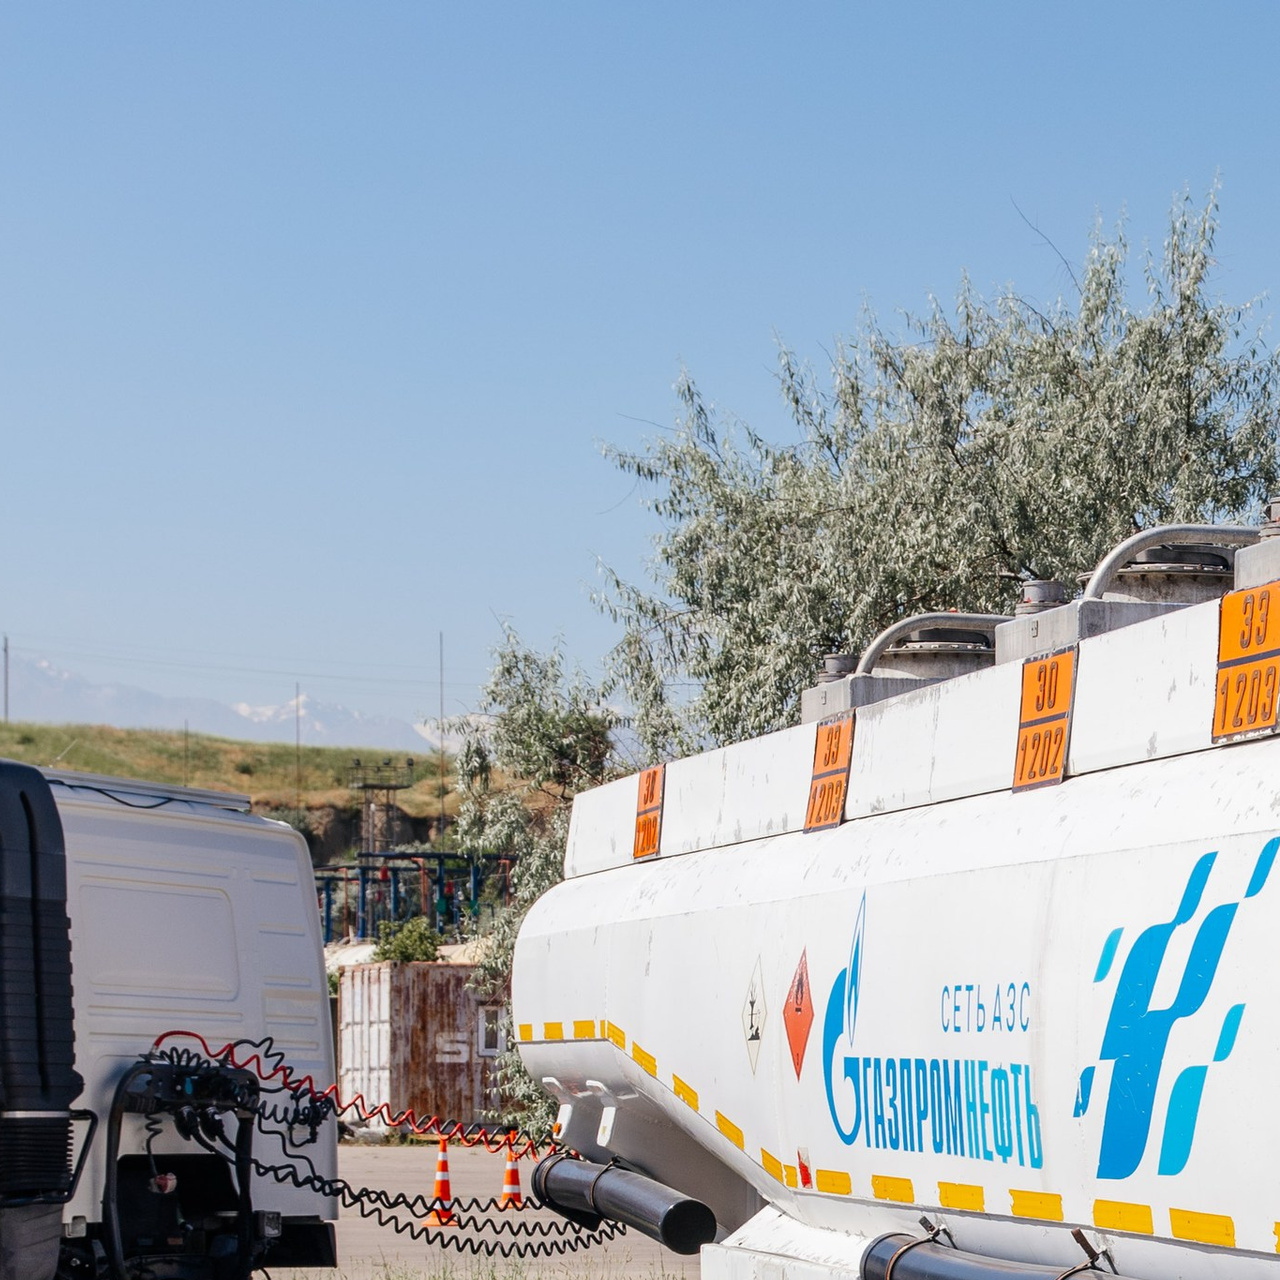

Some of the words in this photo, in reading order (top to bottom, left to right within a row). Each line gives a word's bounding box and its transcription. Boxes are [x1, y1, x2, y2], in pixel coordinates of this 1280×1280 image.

[1239, 589, 1272, 650] 33
[1036, 660, 1060, 710] 30
[1219, 665, 1277, 730] 1203
[824, 724, 841, 767] 33
[1019, 726, 1064, 781] 1202
[808, 780, 842, 824] 1203
[941, 984, 986, 1033] СЕТЬ
[992, 981, 1031, 1033] АЗС
[863, 1056, 1044, 1170] ГАЗПРОМНЕФТЬ
